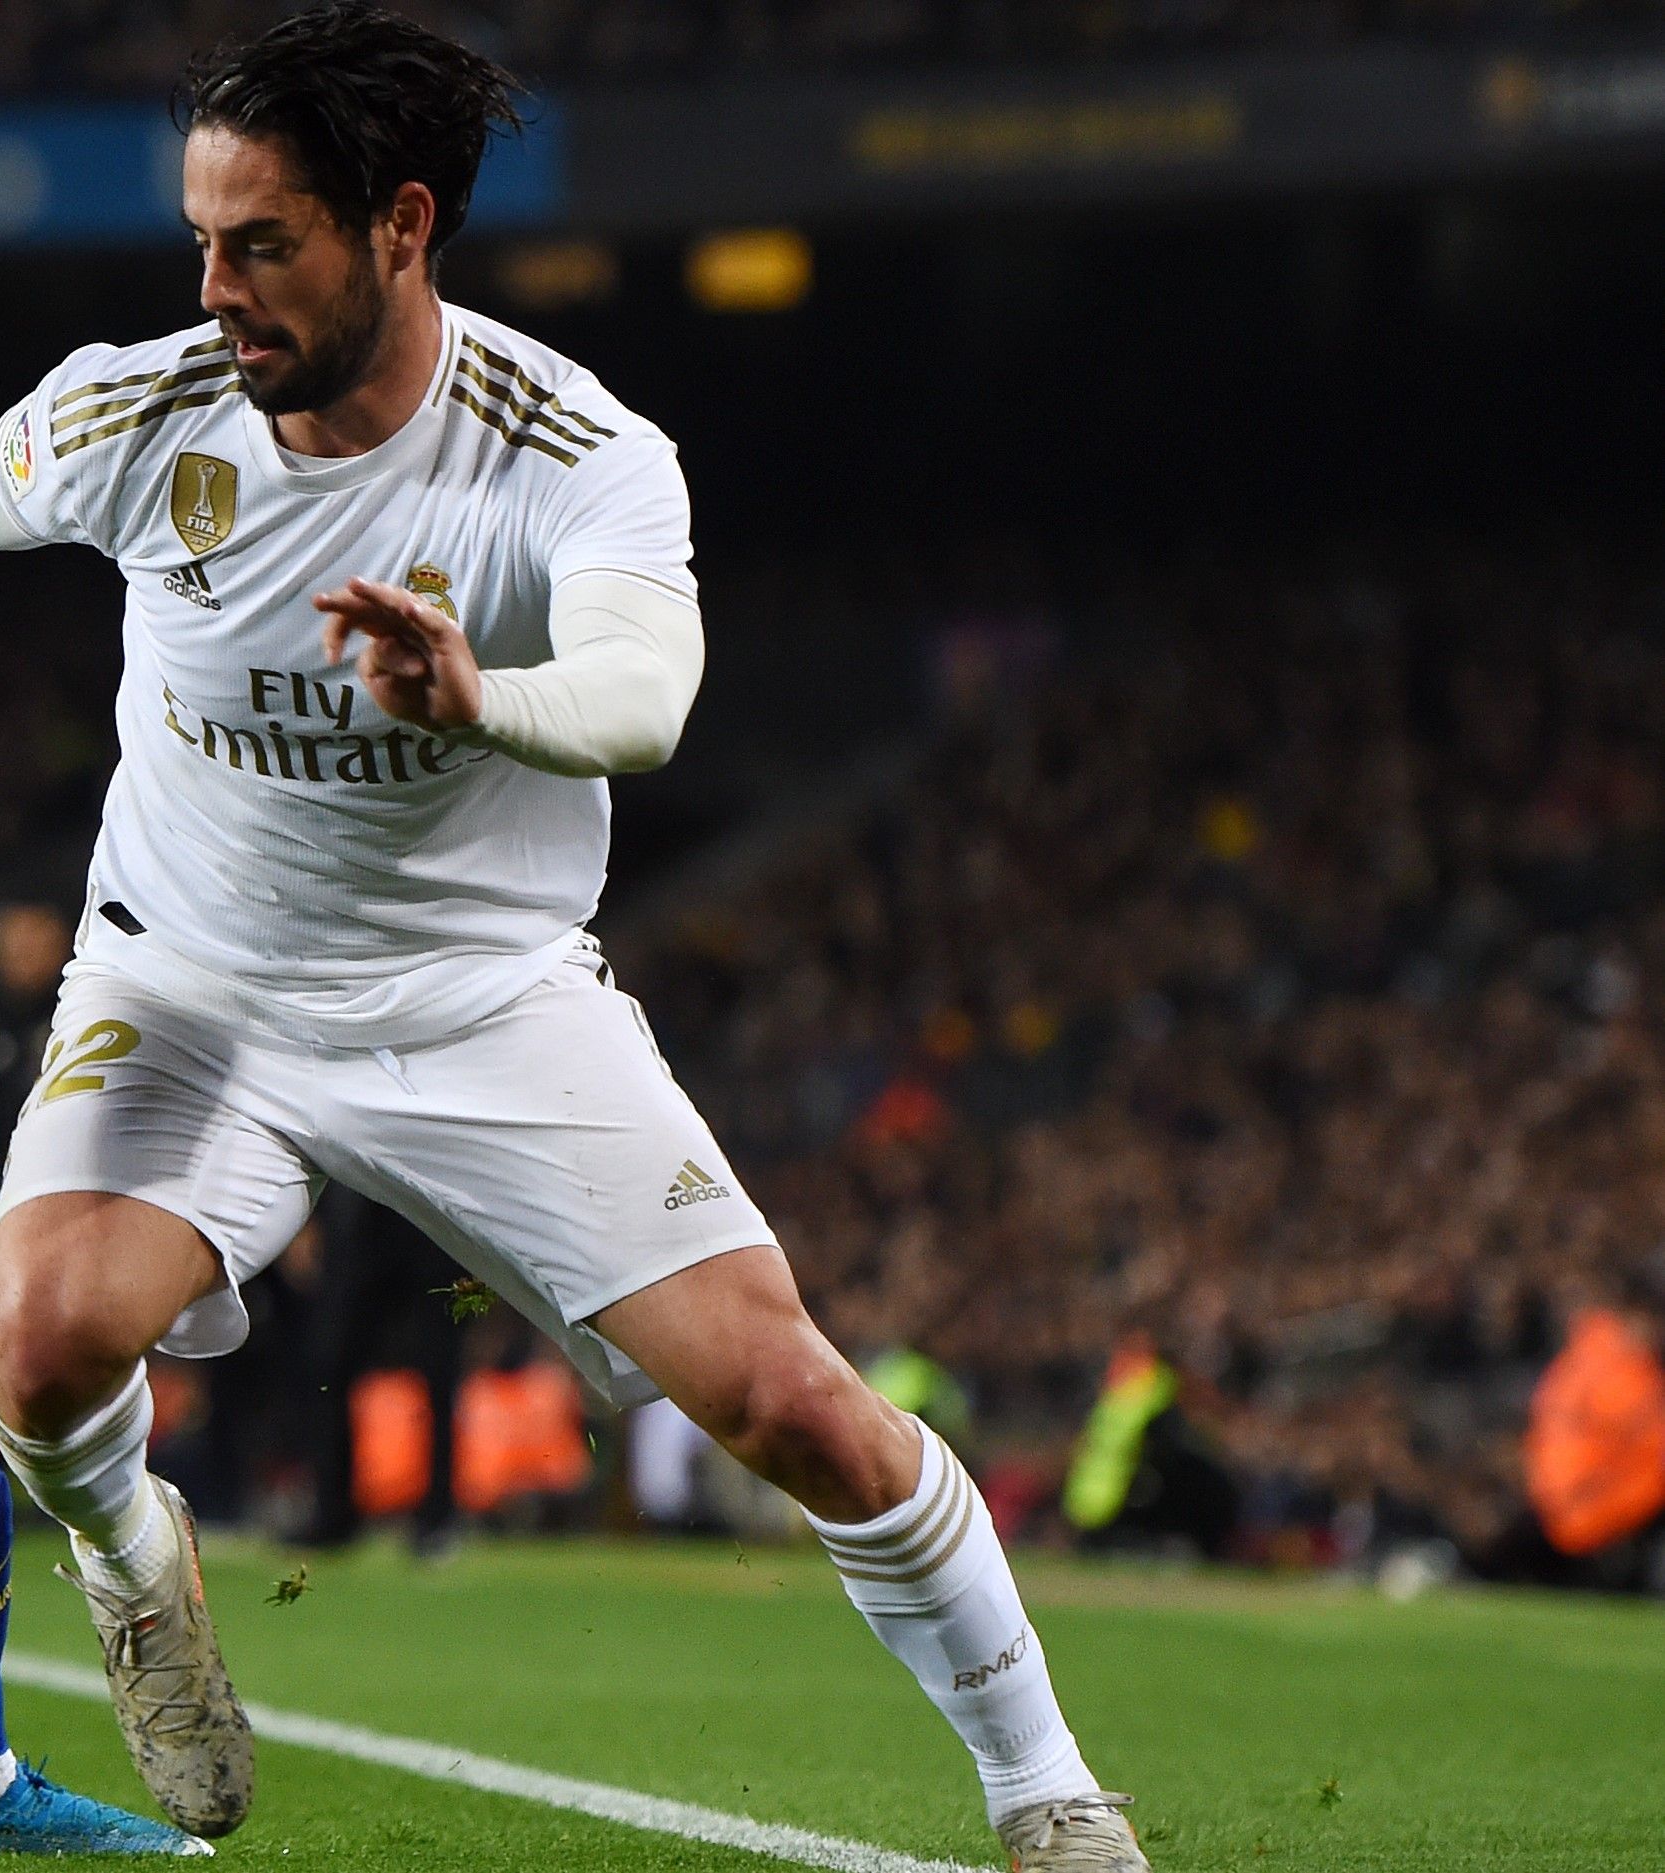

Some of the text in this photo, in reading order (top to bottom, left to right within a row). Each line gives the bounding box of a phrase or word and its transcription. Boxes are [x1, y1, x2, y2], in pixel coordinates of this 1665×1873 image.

[186, 515, 215, 535] FIFA
[163, 577, 222, 611] adidas
[249, 668, 354, 731] Fly
[664, 1185, 731, 1211] adidas
